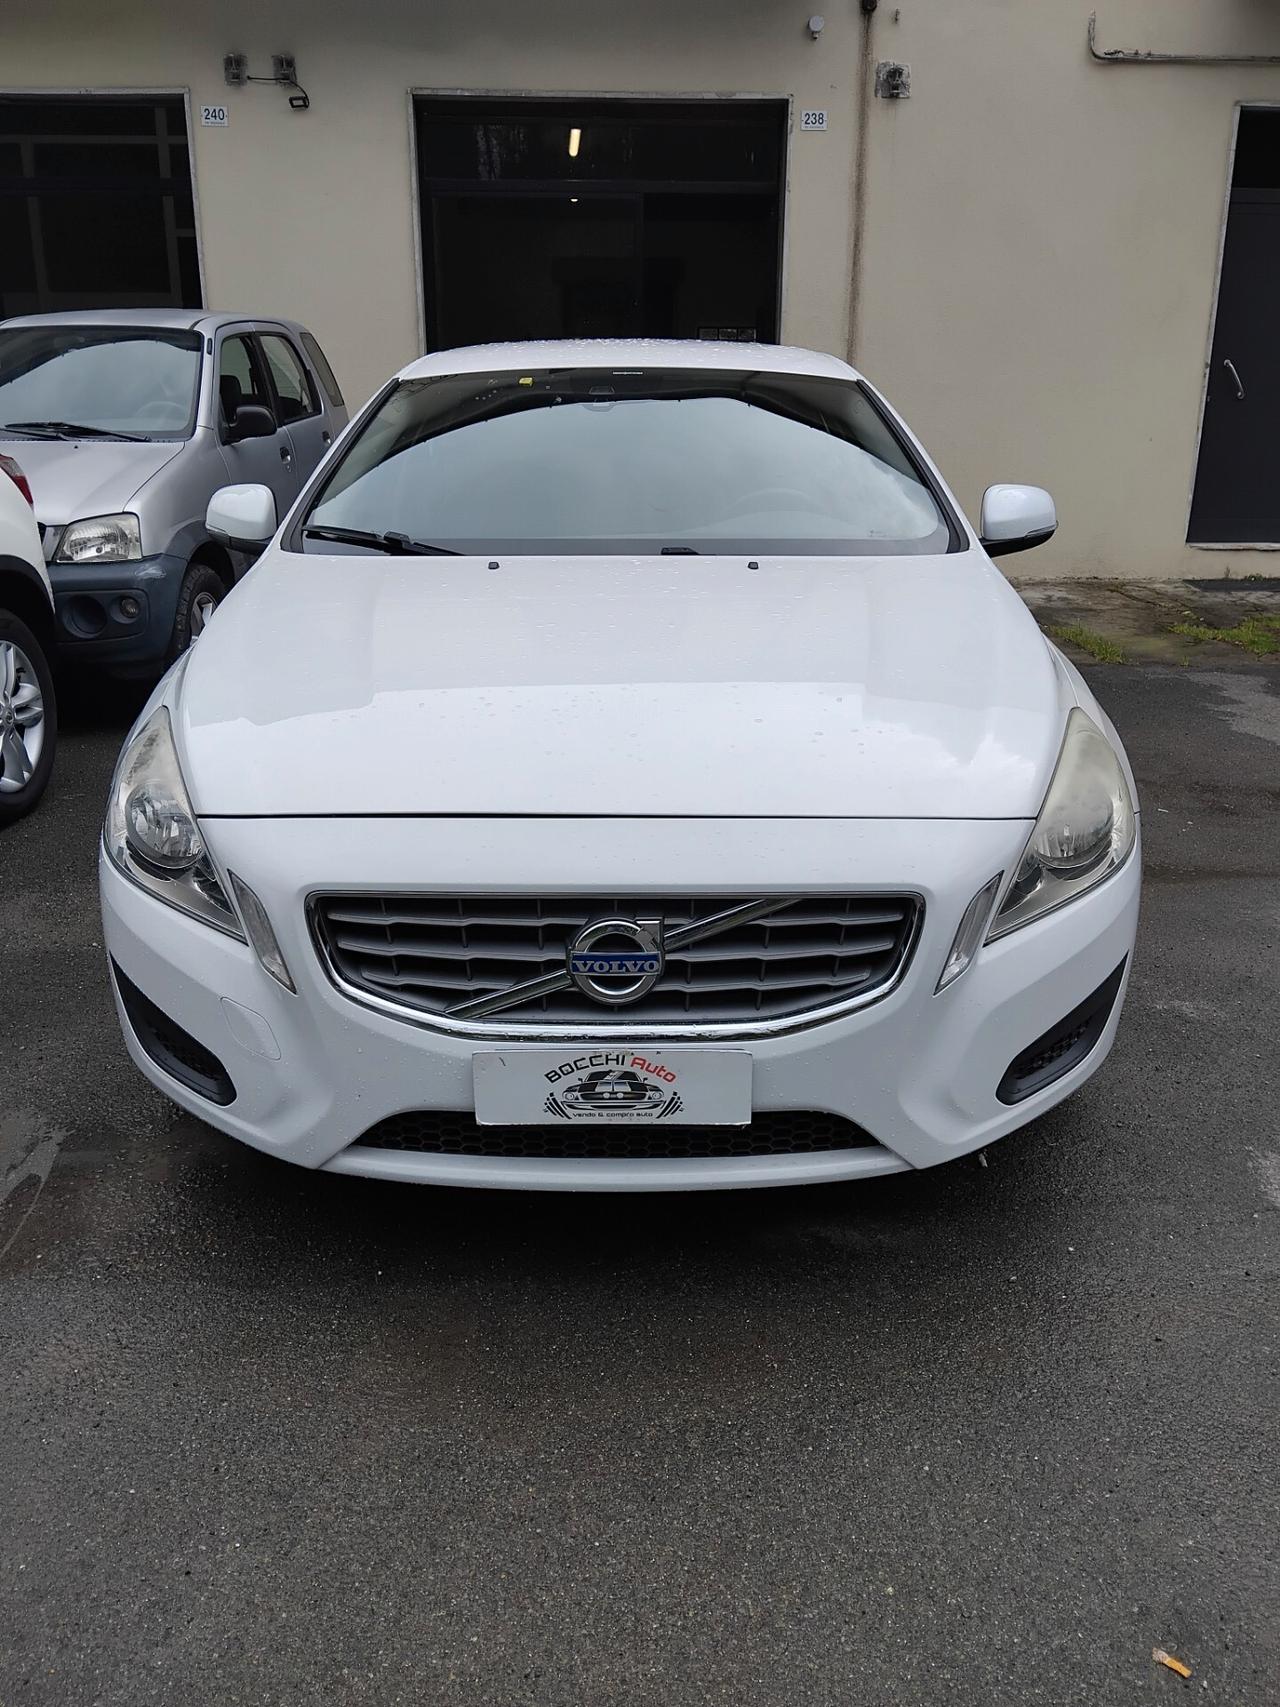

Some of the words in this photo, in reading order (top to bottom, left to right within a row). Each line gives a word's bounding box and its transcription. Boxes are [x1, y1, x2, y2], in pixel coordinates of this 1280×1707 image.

[204, 108, 225, 120] 240
[804, 112, 824, 125] 238
[573, 960, 660, 973] VOLVO
[544, 1054, 625, 1084] BOCCHI
[630, 1056, 677, 1083] Auto
